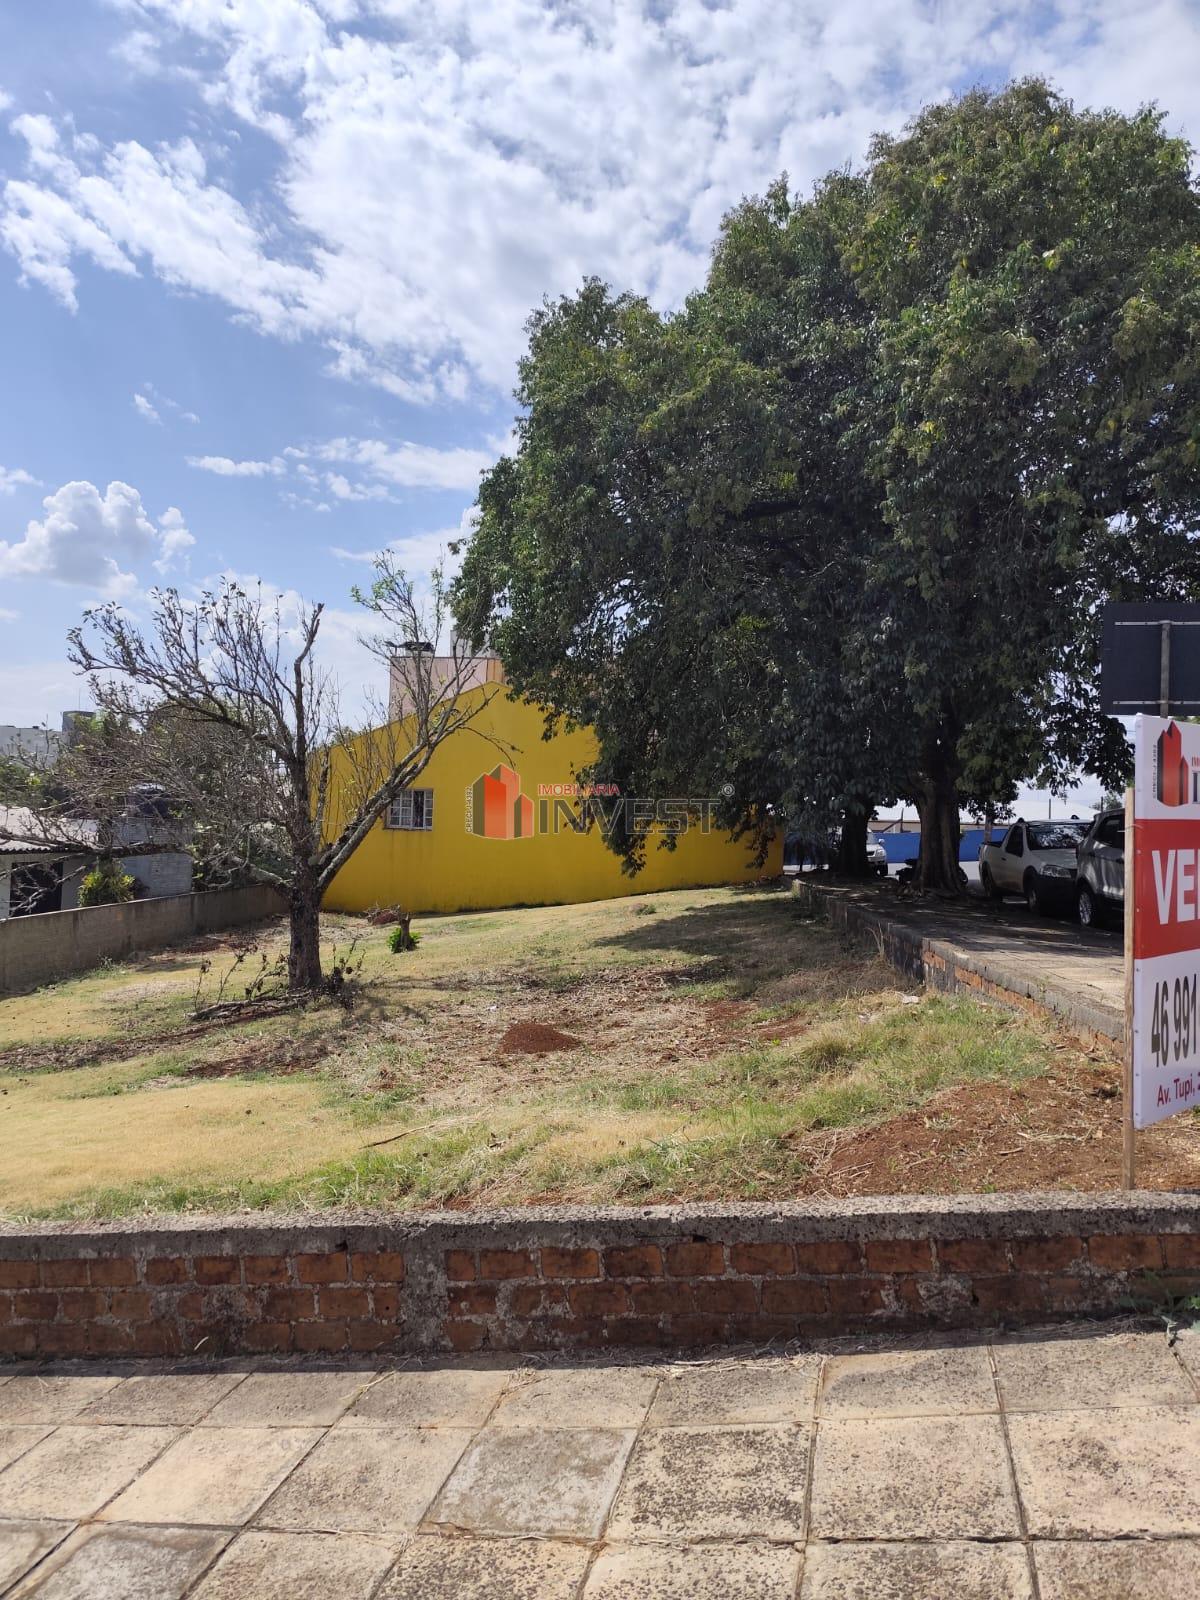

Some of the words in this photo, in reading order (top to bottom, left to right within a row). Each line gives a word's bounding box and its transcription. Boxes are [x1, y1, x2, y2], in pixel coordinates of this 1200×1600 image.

[1152, 849, 1200, 925] VE
[1151, 981, 1169, 1067] 46
[1157, 1085, 1172, 1107] Av.
[1174, 1073, 1196, 1101] Tupi,
